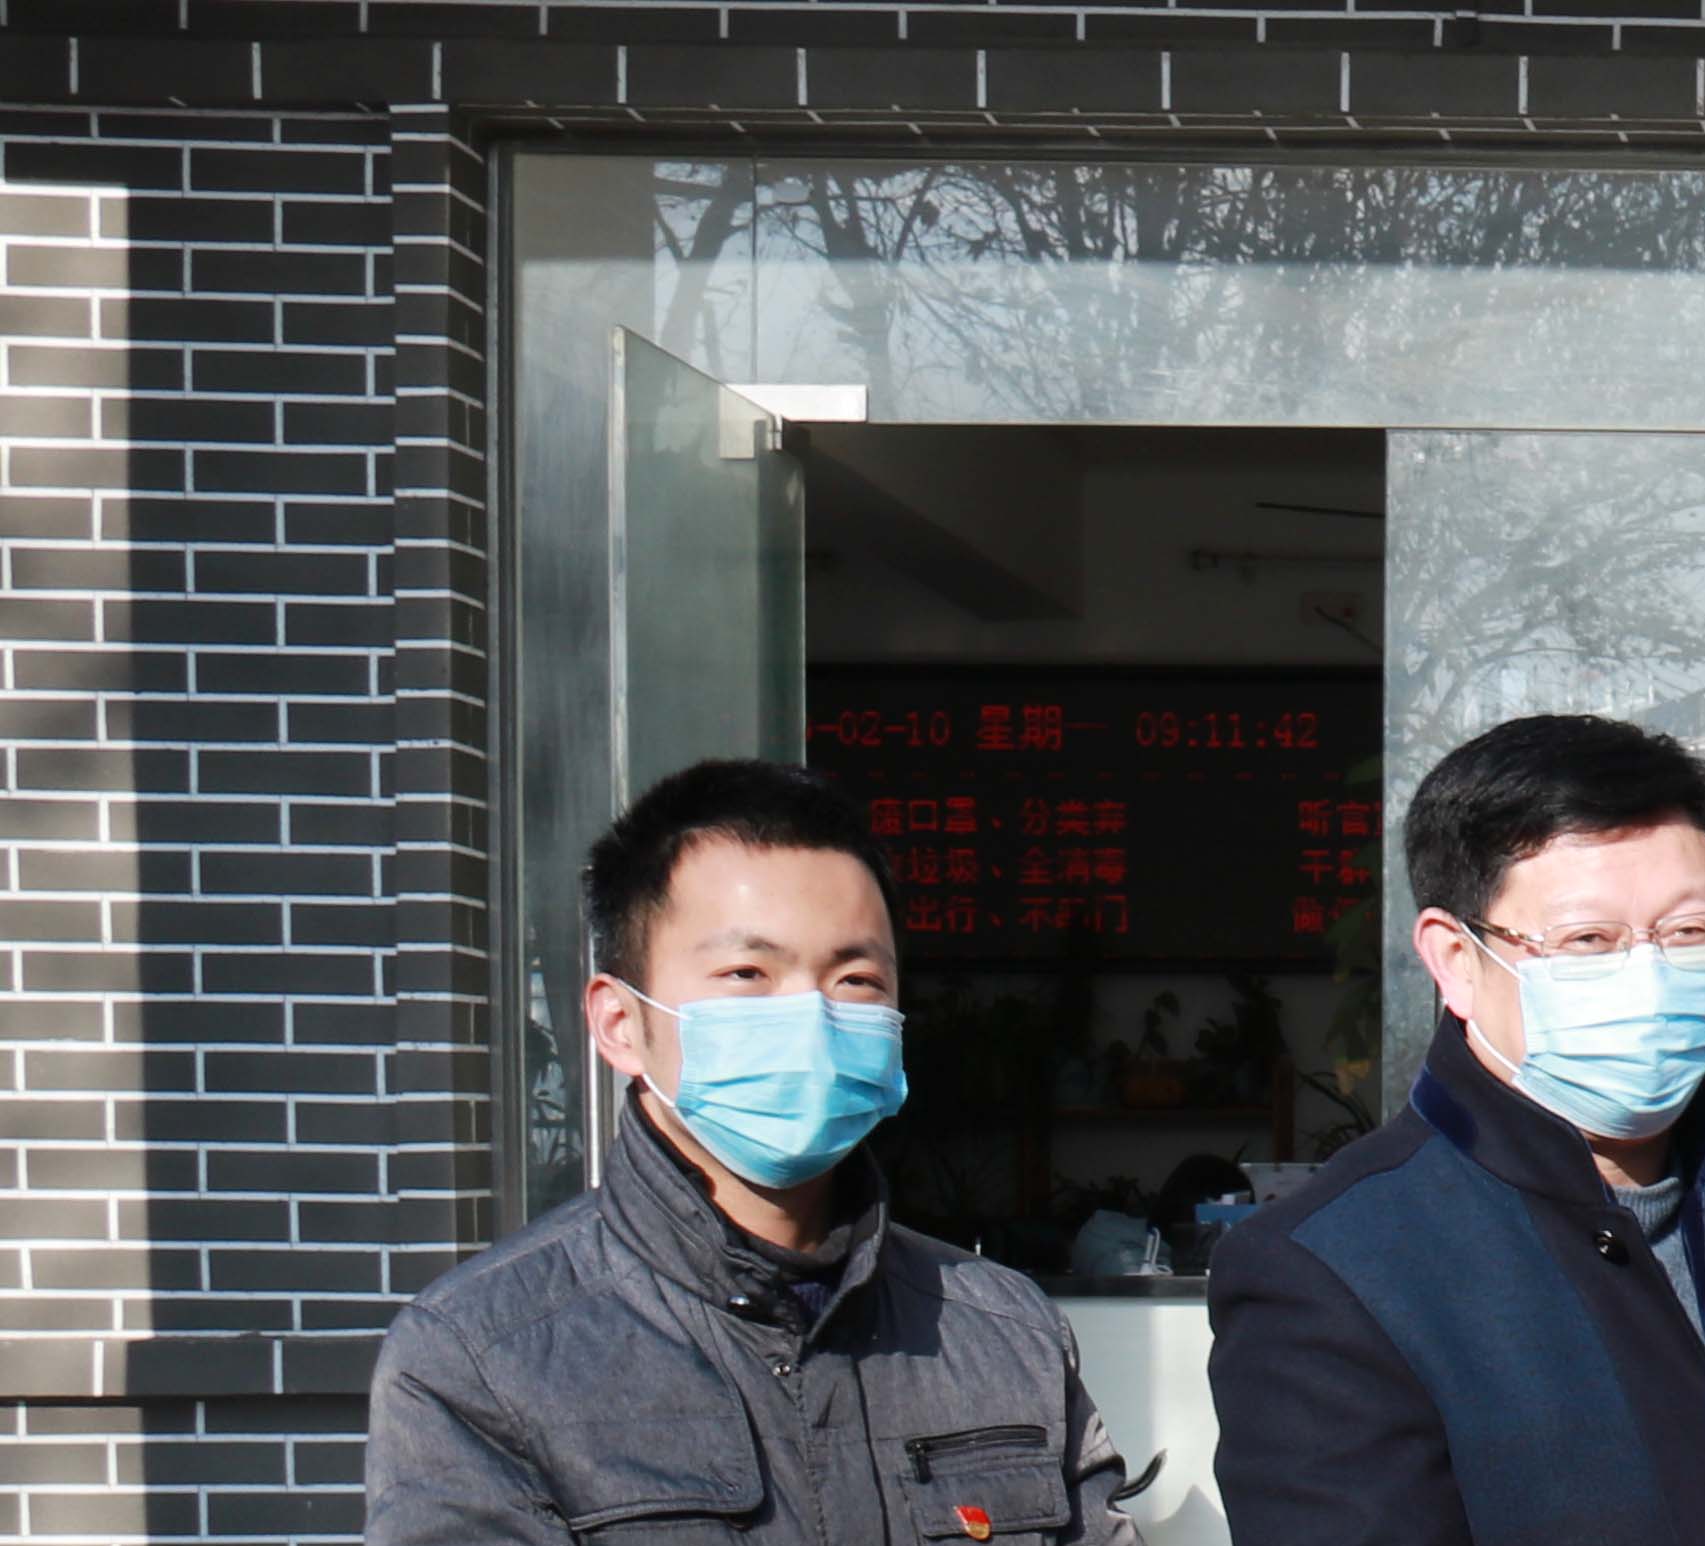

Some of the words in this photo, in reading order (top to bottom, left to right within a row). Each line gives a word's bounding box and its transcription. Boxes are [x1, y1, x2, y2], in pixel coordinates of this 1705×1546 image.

[805, 711, 950, 747] -02-10
[975, 705, 1108, 751] 星期一
[1136, 711, 1319, 748] 09:11:42
[893, 846, 1128, 886] 垃圾、全消毒
